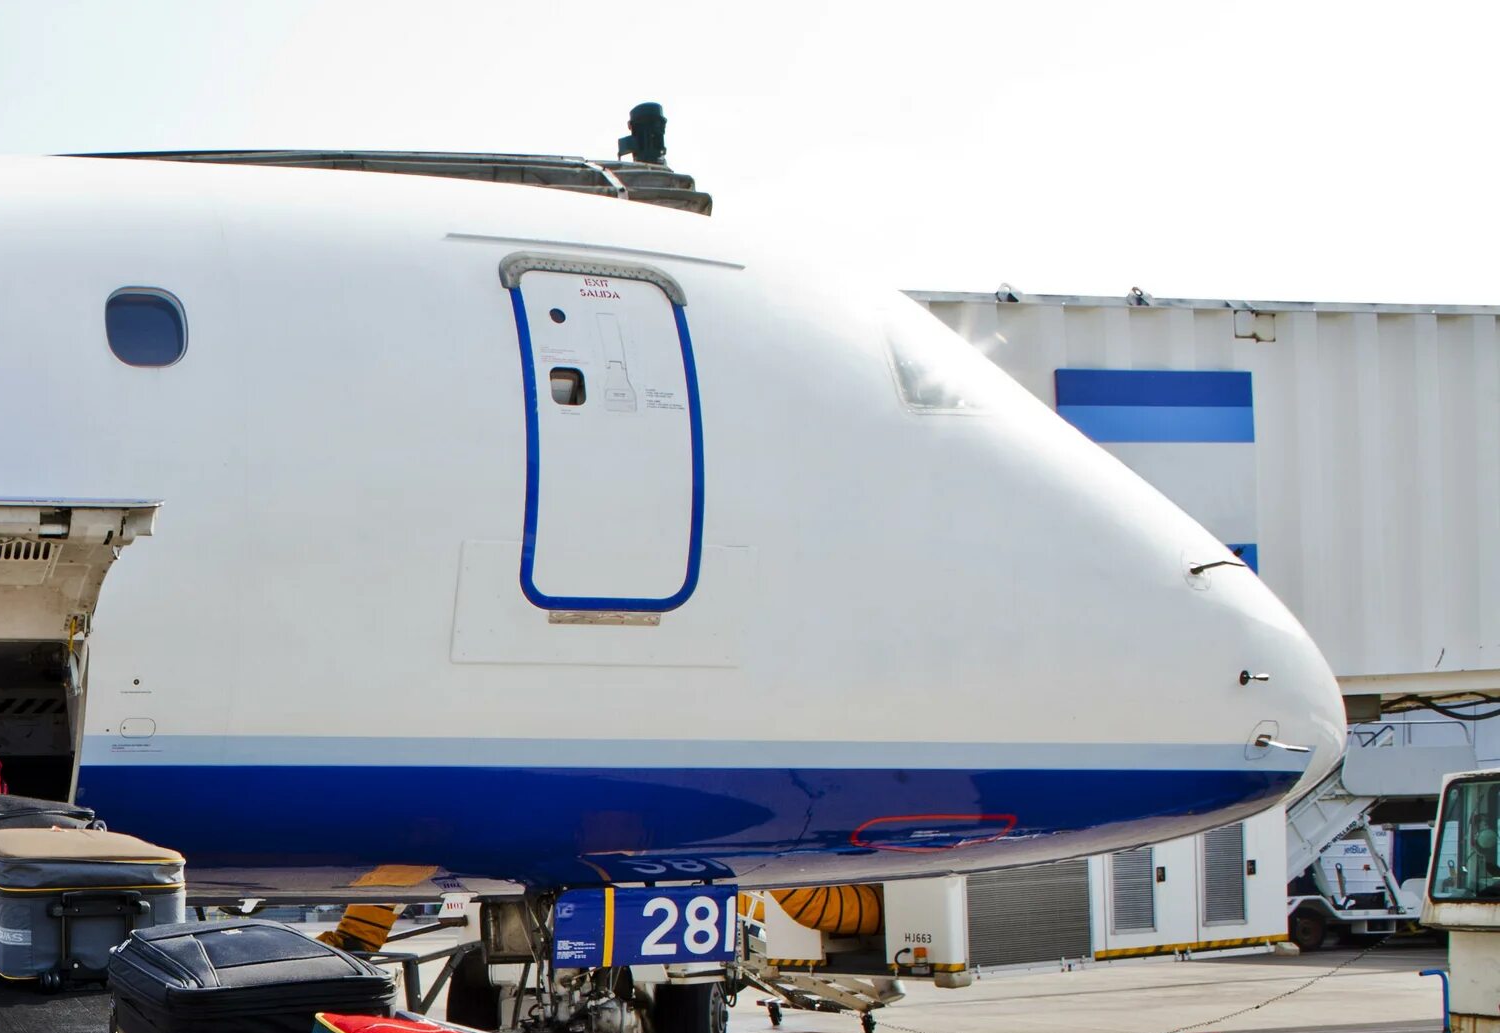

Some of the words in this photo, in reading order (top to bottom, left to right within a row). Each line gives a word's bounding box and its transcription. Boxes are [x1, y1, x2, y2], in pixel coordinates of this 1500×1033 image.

[584, 279, 608, 287] EXIT
[580, 288, 621, 299] SALIDA
[1344, 845, 1367, 855] jetBlue
[446, 902, 464, 910] HOT
[641, 895, 736, 956] 281
[904, 933, 932, 943] HJ663
